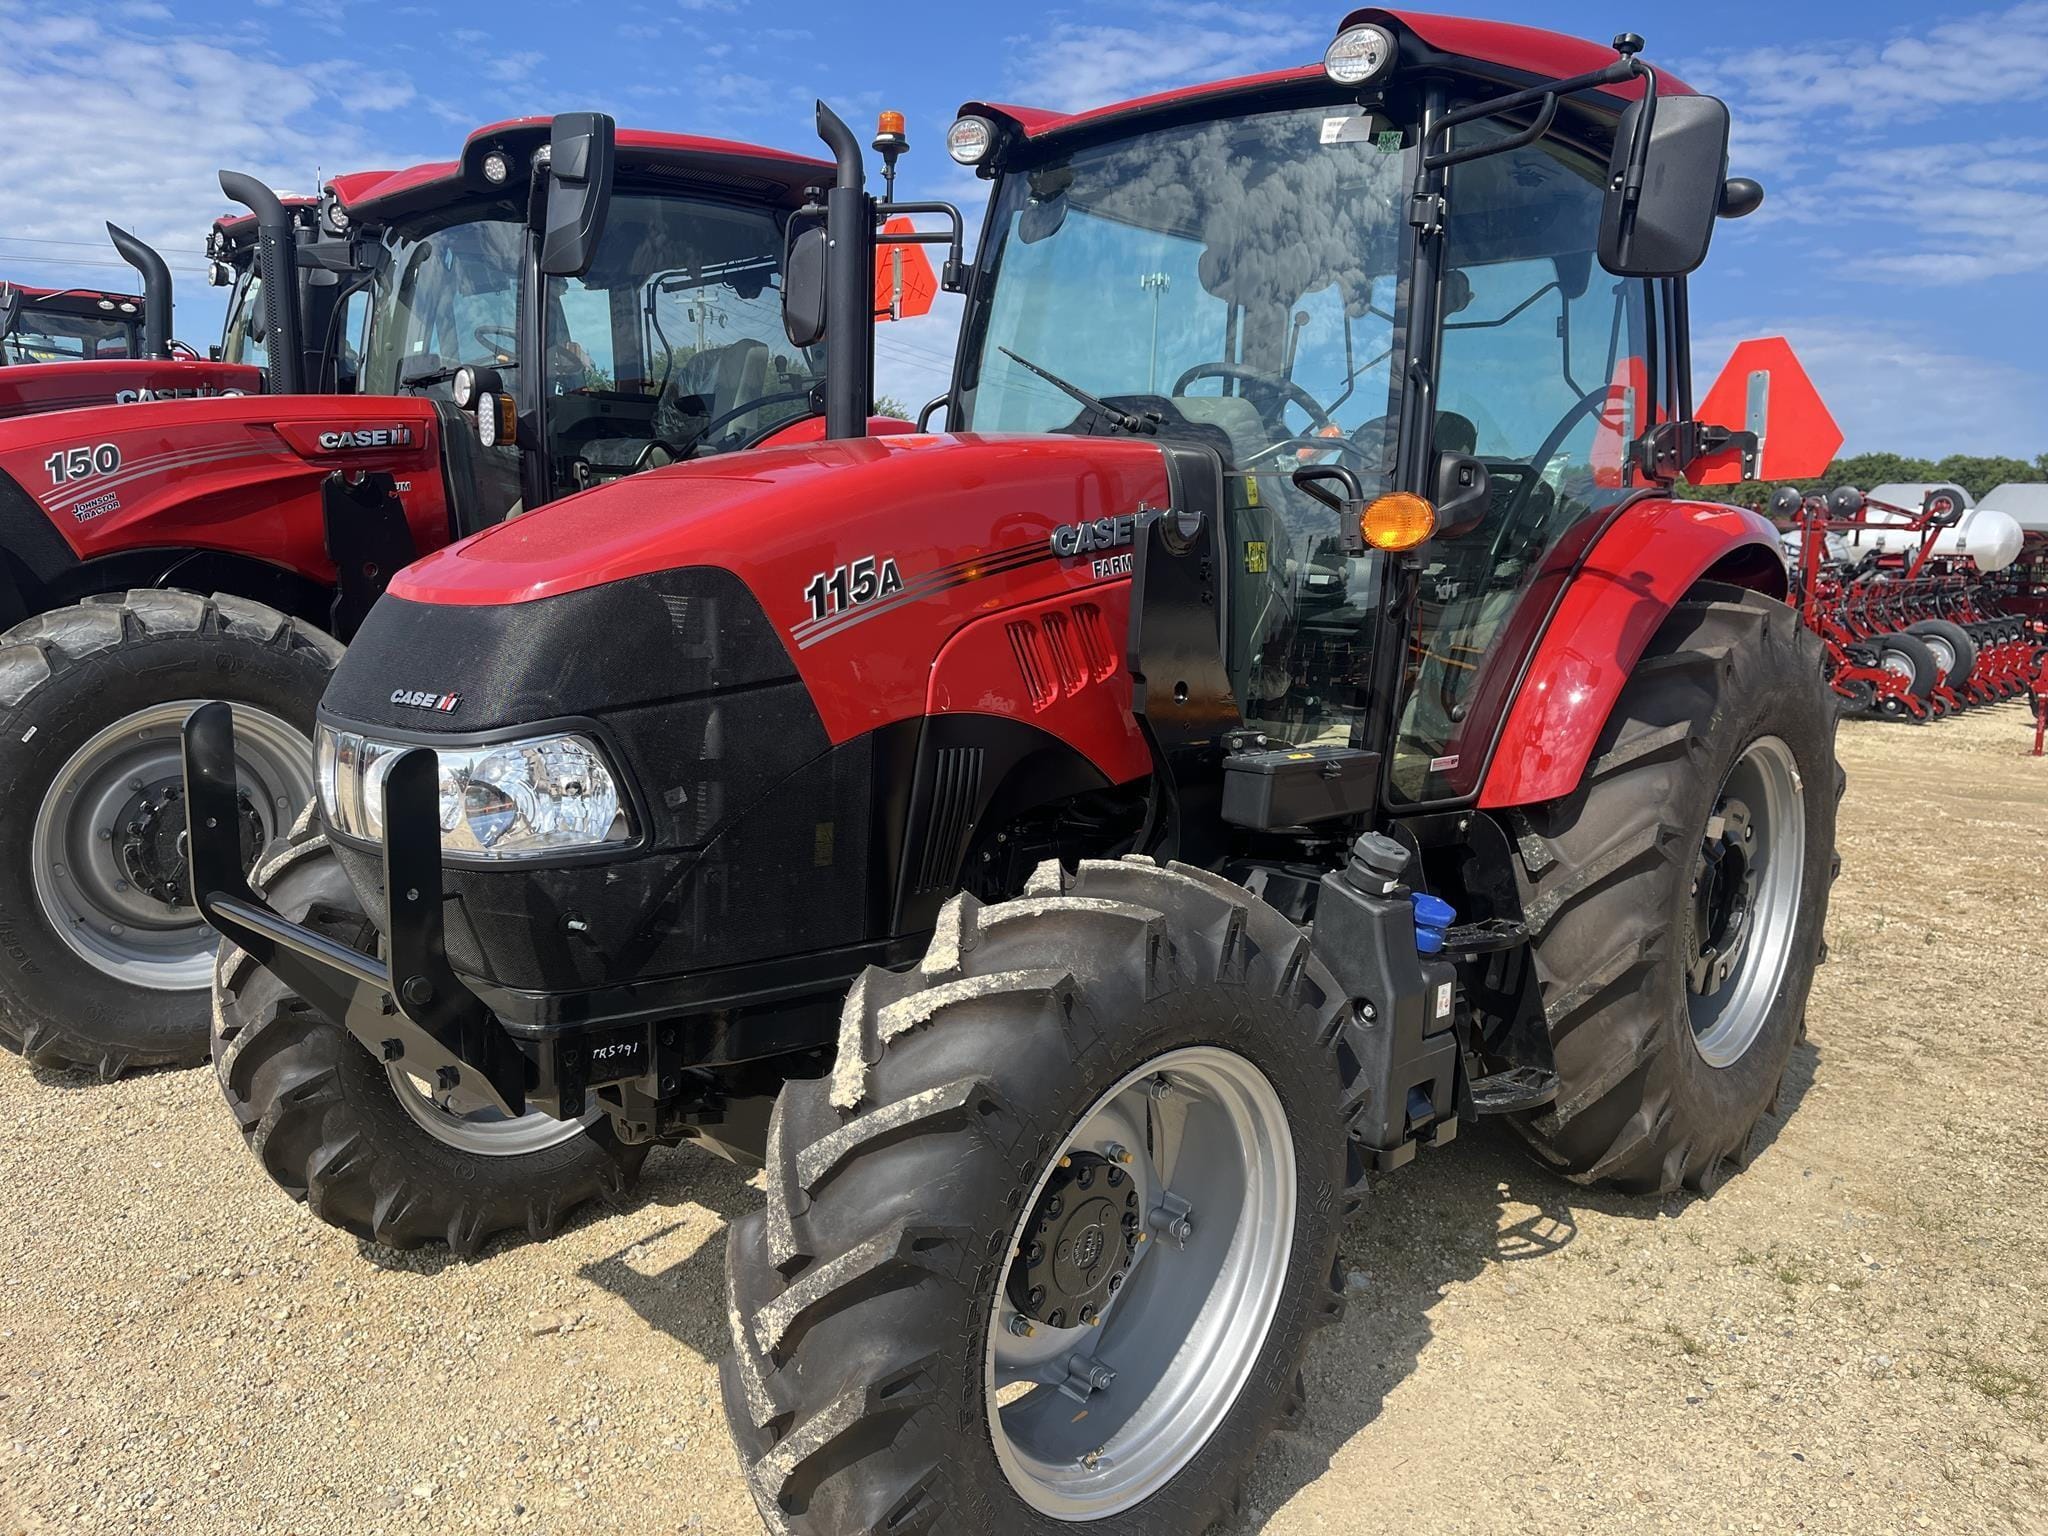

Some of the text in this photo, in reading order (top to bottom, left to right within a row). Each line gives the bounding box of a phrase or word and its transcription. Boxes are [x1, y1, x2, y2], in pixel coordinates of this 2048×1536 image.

[319, 429, 387, 449] CASE
[45, 443, 121, 484] 150
[72, 491, 116, 516] JOHNSON
[76, 501, 120, 523] TRACTOR
[1050, 514, 1133, 556] CASE
[804, 555, 905, 622] 115A
[390, 688, 438, 708] CASE
